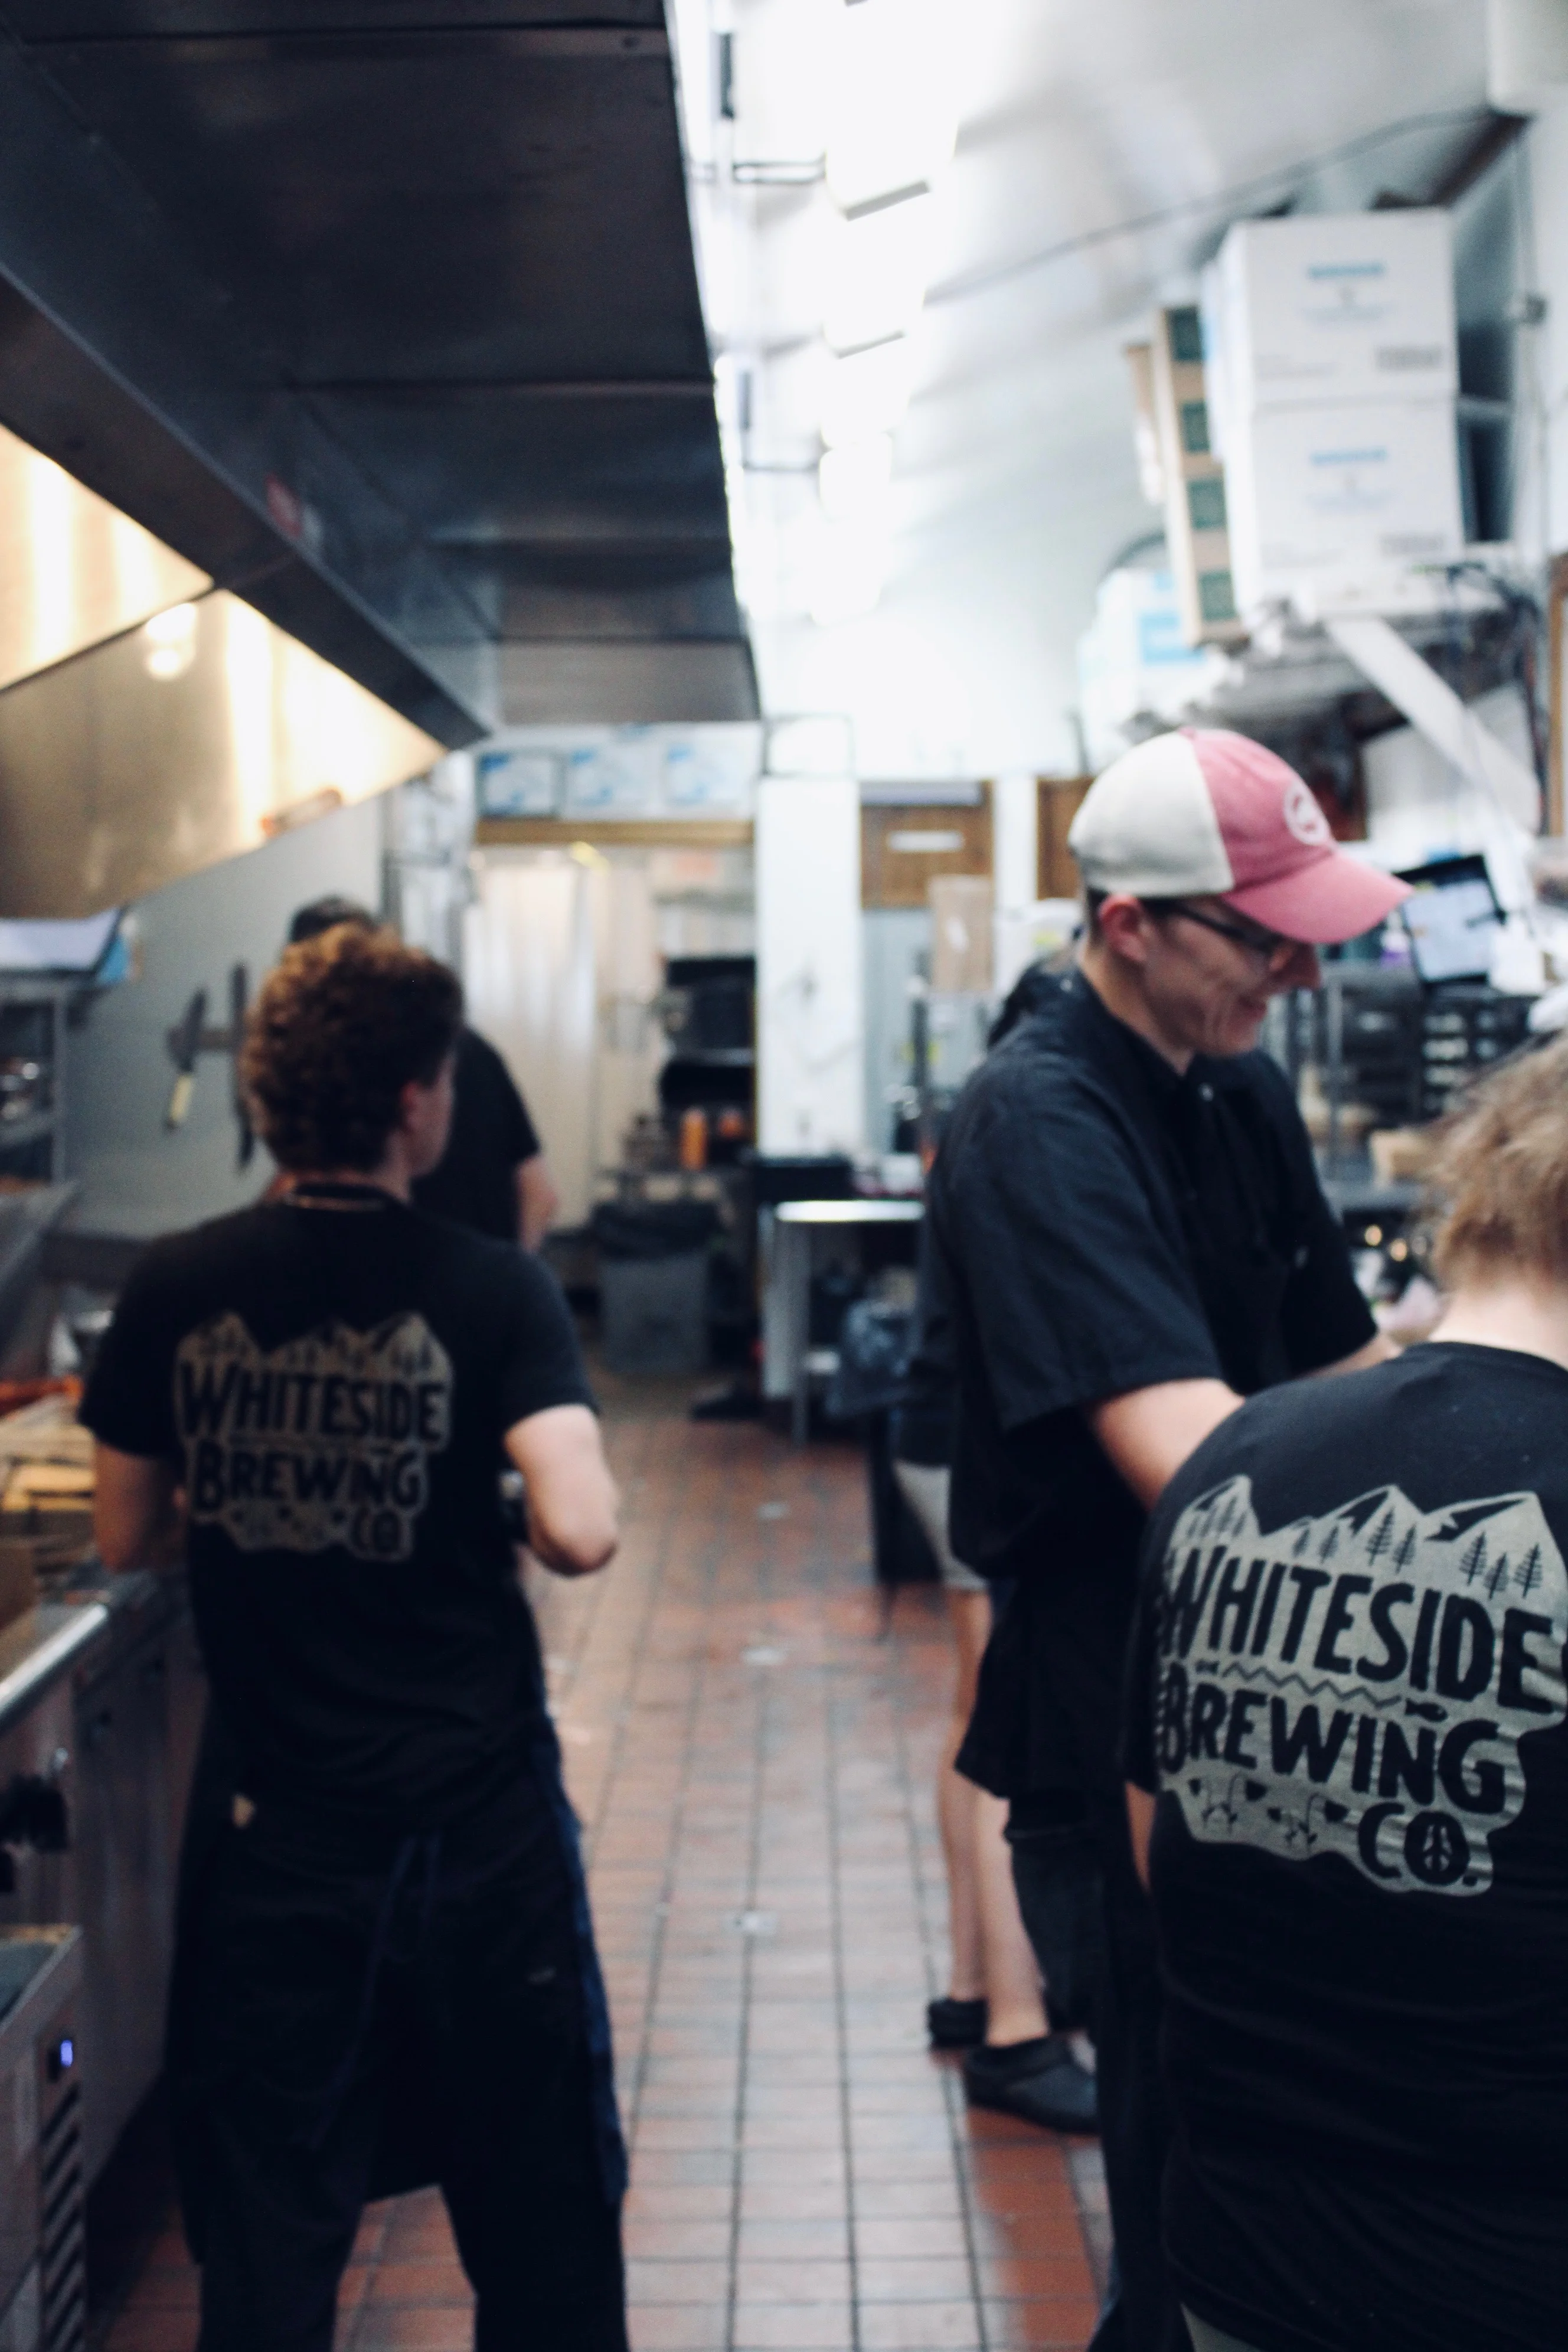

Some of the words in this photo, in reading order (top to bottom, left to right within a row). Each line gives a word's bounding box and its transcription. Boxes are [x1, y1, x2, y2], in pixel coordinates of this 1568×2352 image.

[183, 1361, 445, 1440] WHITESIDE
[1158, 1544, 1559, 1714] WHITESIDE
[1158, 1662, 1506, 1815] BREWING
[1358, 1802, 1478, 1886] CO.
